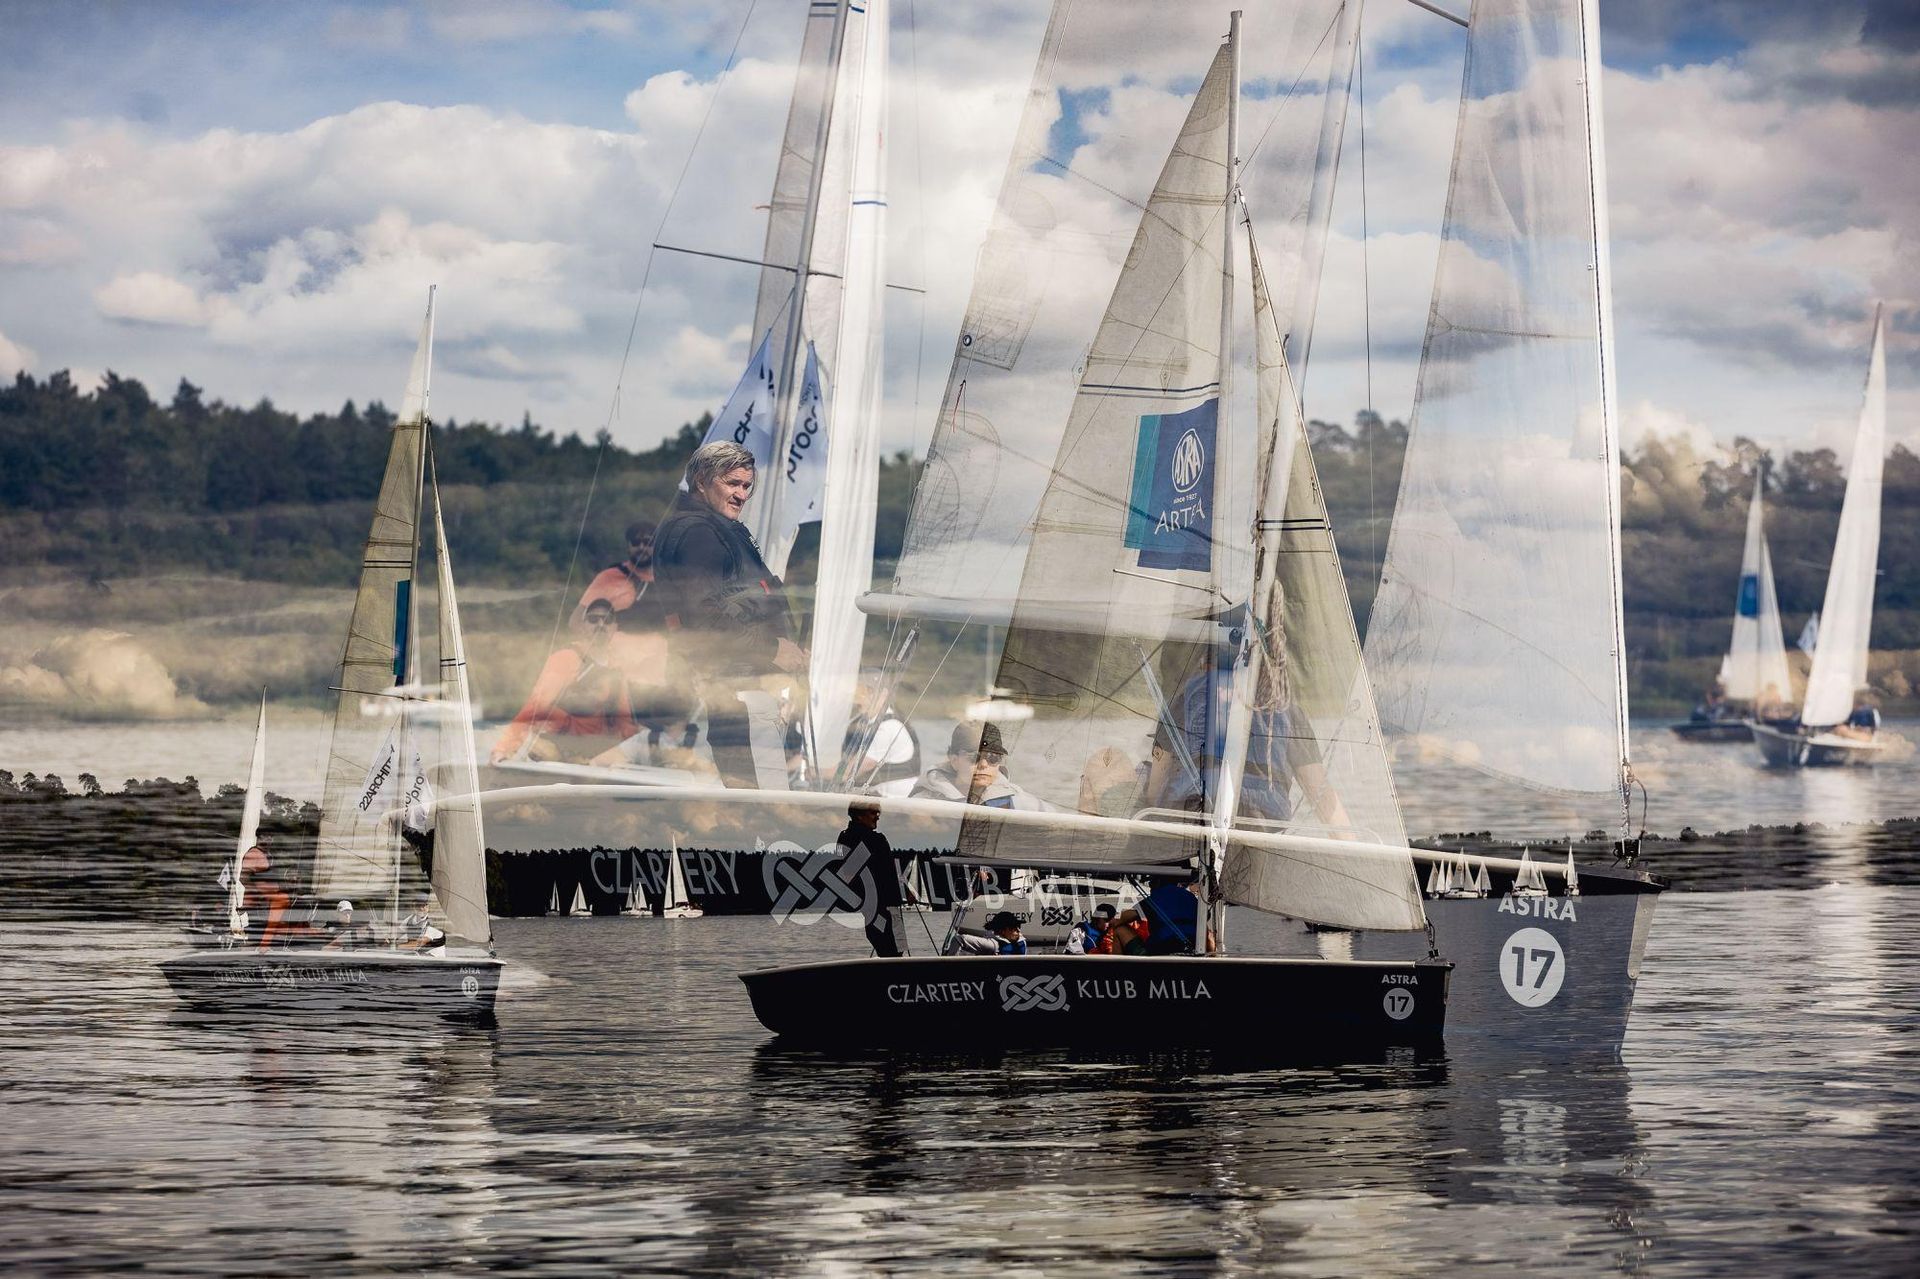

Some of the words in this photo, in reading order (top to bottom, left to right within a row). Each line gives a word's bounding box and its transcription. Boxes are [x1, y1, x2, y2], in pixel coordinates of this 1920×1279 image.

[589, 850, 740, 896] CZARTERY
[894, 857, 1005, 911] KLUB
[1028, 869, 1148, 922] MILA
[1497, 892, 1577, 922] ASTRA
[298, 968, 330, 983] KLUB
[334, 969, 368, 983] MILA
[459, 967, 481, 975] ASTRA
[1511, 946, 1556, 989] 17
[463, 981, 477, 993] 18
[1381, 974, 1419, 985] ASTRA
[887, 981, 986, 1003] CZARTERY
[1076, 979, 1138, 1000] KLUB
[1149, 979, 1213, 1000] MILA
[1388, 995, 1410, 1013] 17
